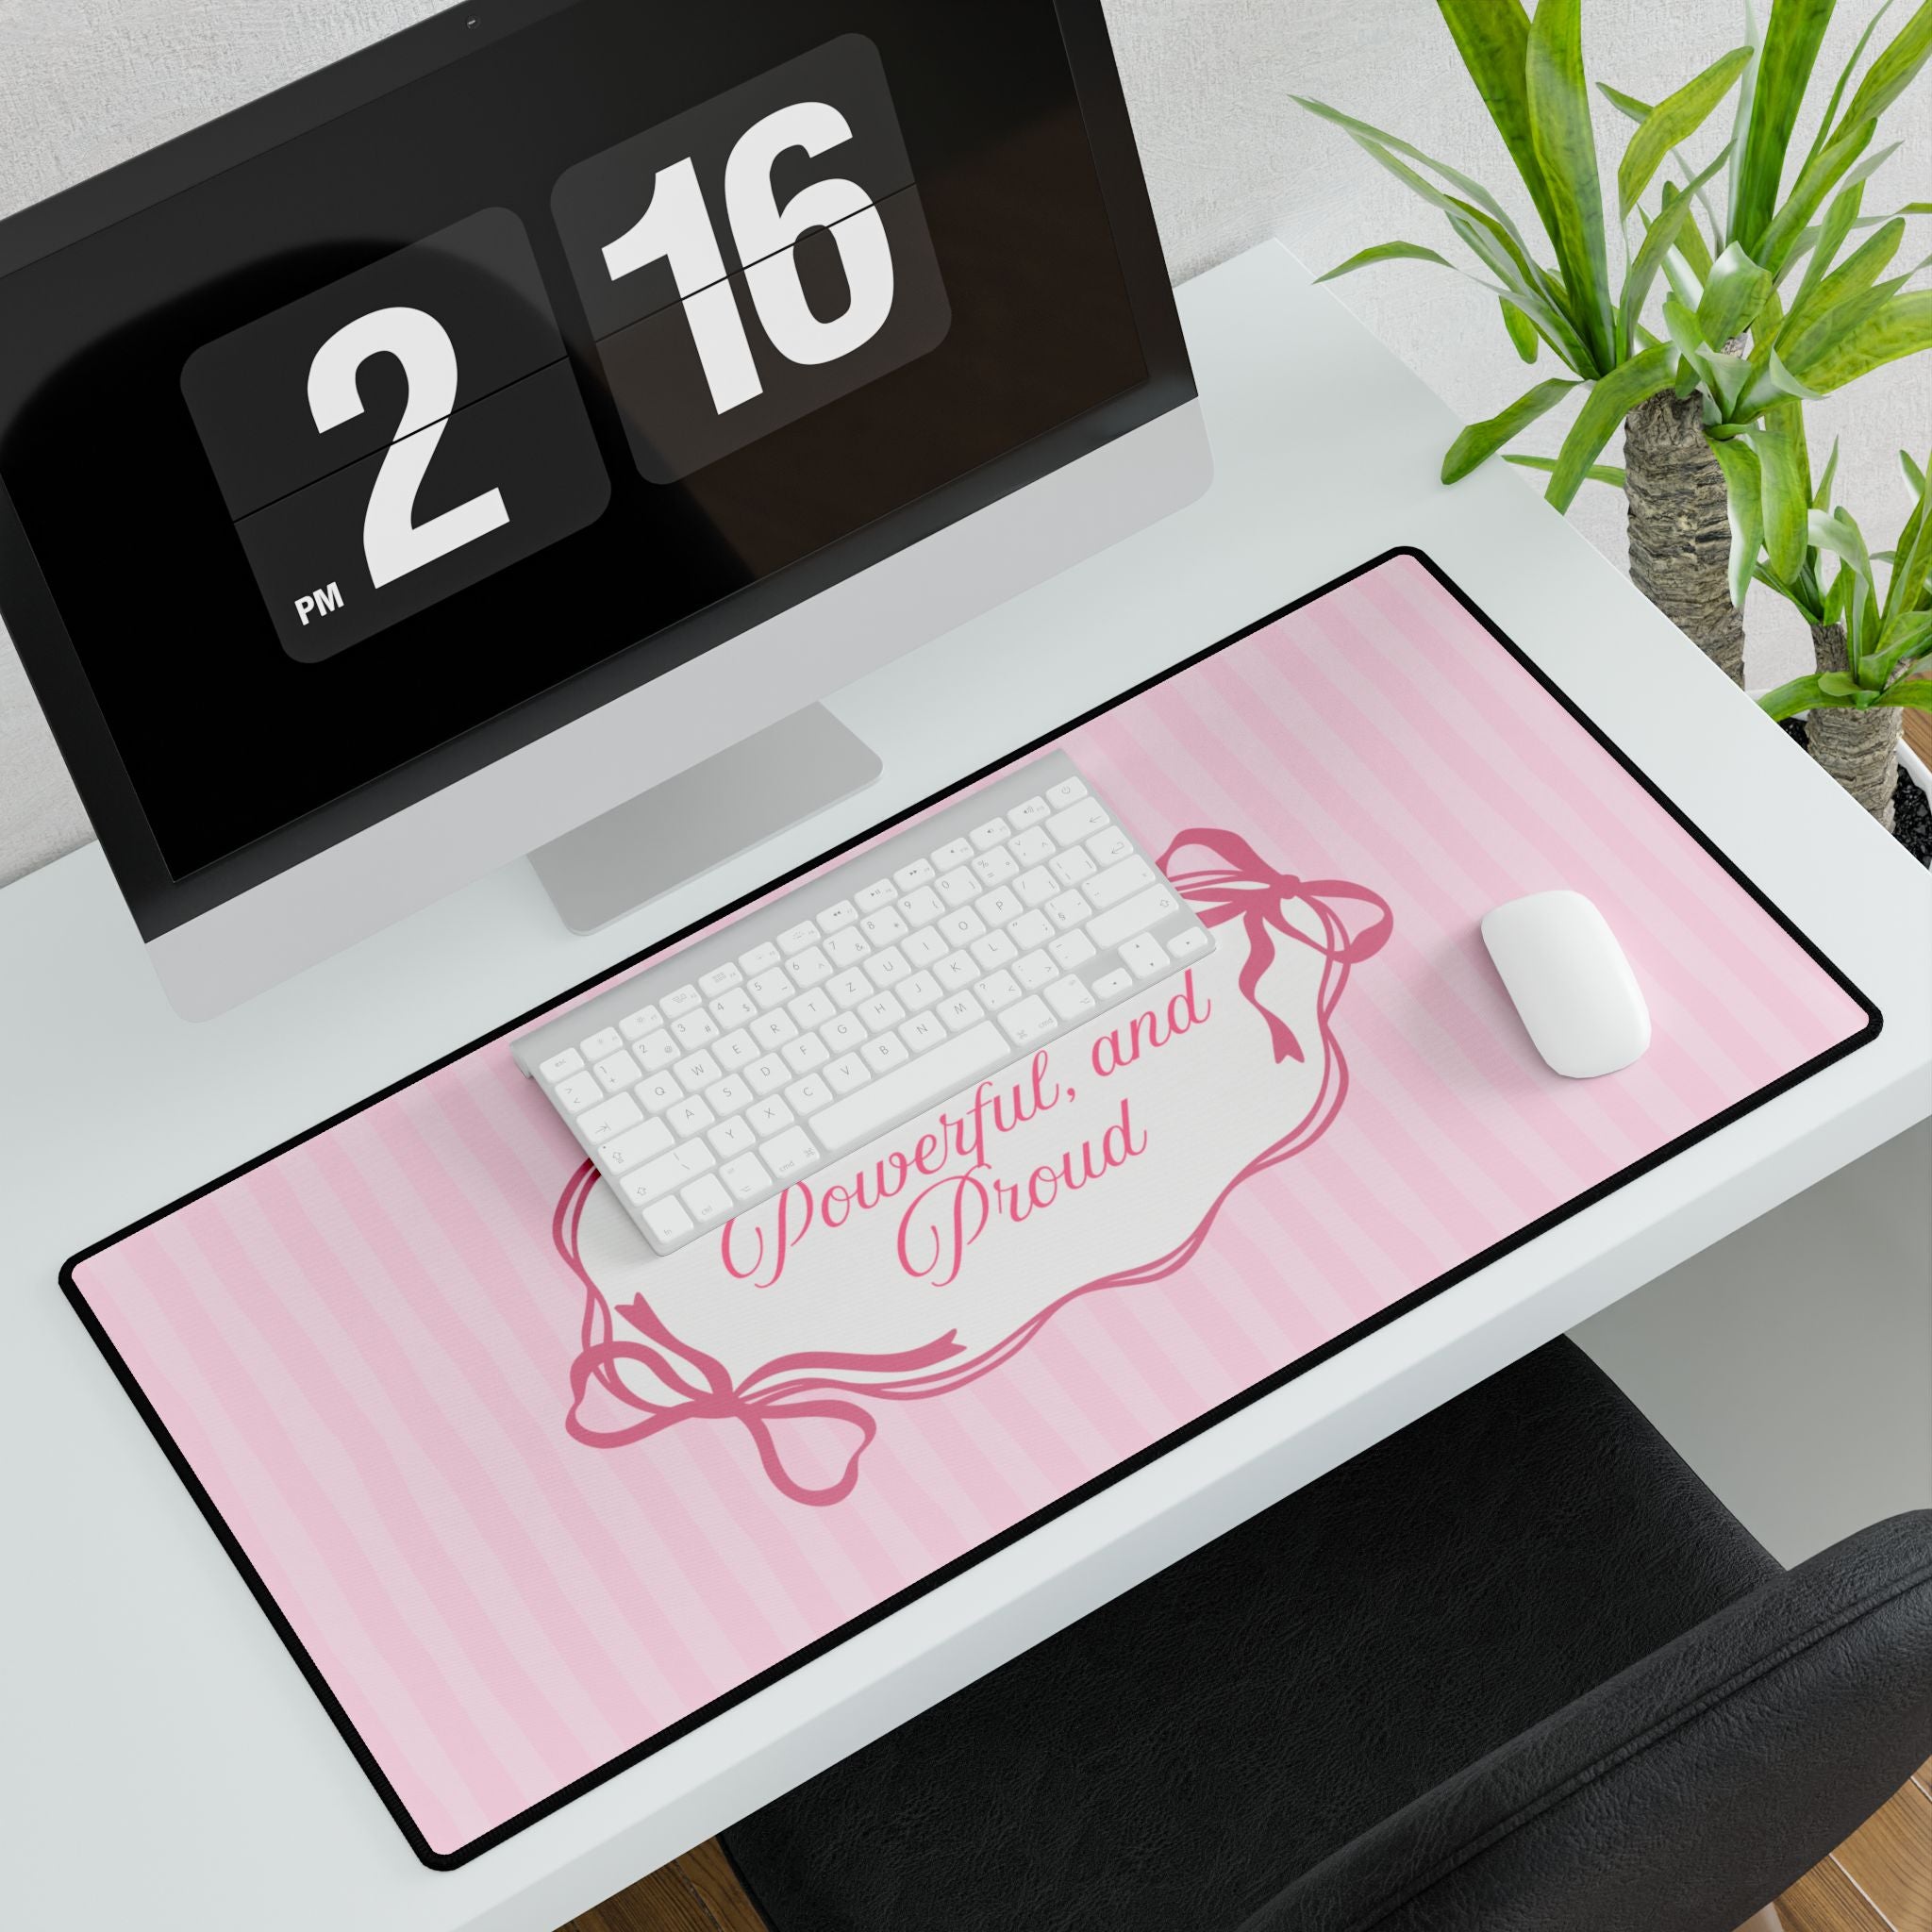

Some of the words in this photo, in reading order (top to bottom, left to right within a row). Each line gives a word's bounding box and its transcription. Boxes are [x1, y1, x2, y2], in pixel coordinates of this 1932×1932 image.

[307, 307, 510, 590] 2
[602, 102, 893, 414] 16
[294, 581, 344, 626] PM
[904, 901, 911, 909] 9
[996, 900, 1004, 909] P
[868, 921, 875, 930] 8
[958, 921, 968, 930] O
[828, 941, 837, 950] 7
[989, 943, 998, 952] L
[792, 962, 800, 971] 6
[883, 961, 893, 972] U
[951, 962, 962, 972] K
[755, 982, 761, 991] 5
[846, 982, 857, 992] Z
[915, 983, 923, 994] J
[717, 1003, 724, 1011] 4
[808, 1003, 817, 1012] T
[874, 1004, 887, 1015] H
[954, 1003, 966, 1015] M
[677, 1024, 686, 1032] 3
[771, 1024, 780, 1034] R
[837, 1024, 847, 1034] G
[917, 1024, 928, 1034] N
[640, 1044, 648, 1054] 2
[732, 1045, 742, 1055] E
[800, 1045, 808, 1055] F
[879, 1045, 889, 1056] B
[691, 1064, 705, 1076] W
[760, 1066, 772, 1076] D
[840, 1066, 849, 1075] V
[655, 1087, 665, 1096] Q
[723, 1088, 732, 1097] S
[804, 1087, 813, 1096] C
[685, 1108, 694, 1120] A
[764, 1108, 775, 1119] X
[721, 1050, 1076, 1289] Powerful,
[1091, 968, 1211, 1077] and
[724, 1128, 734, 1140] Y
[896, 1098, 1148, 1288] Proud
